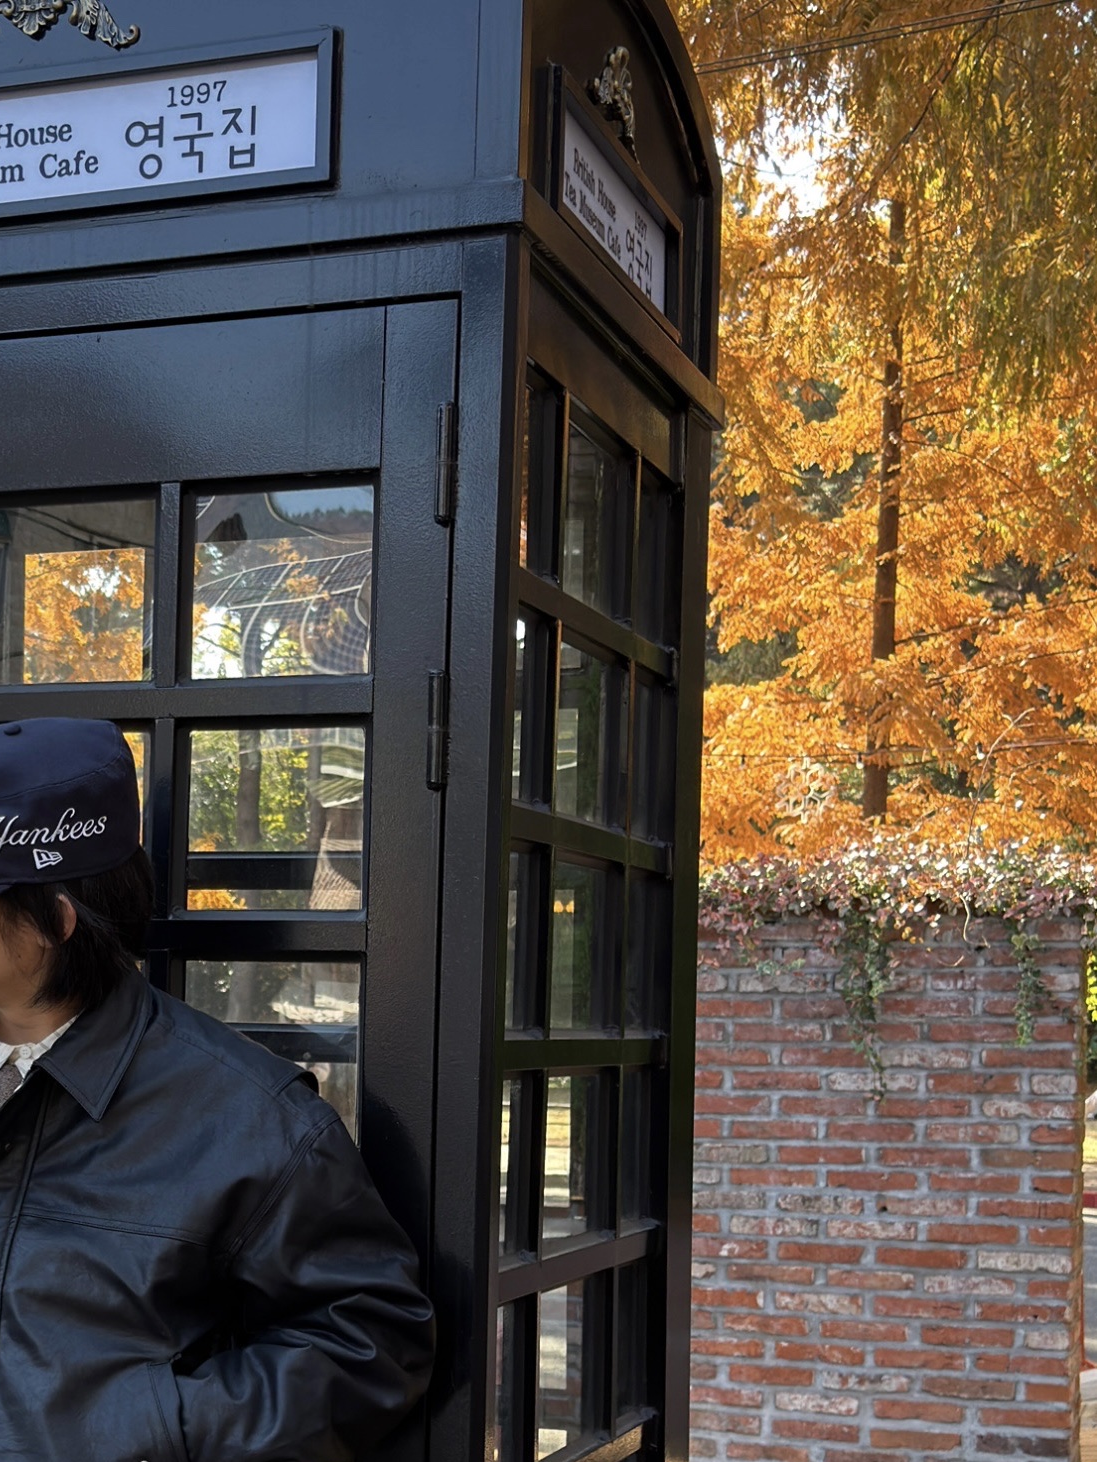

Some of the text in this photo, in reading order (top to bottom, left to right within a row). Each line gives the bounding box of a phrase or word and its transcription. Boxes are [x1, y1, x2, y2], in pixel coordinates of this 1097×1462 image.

[167, 80, 228, 109] 1997
[38, 150, 99, 180] Cafe
[124, 105, 257, 180] 영국집
[564, 170, 578, 208] Tea
[607, 225, 622, 261] Cafe
[573, 147, 616, 223] British House
[625, 228, 653, 301] 영국집
